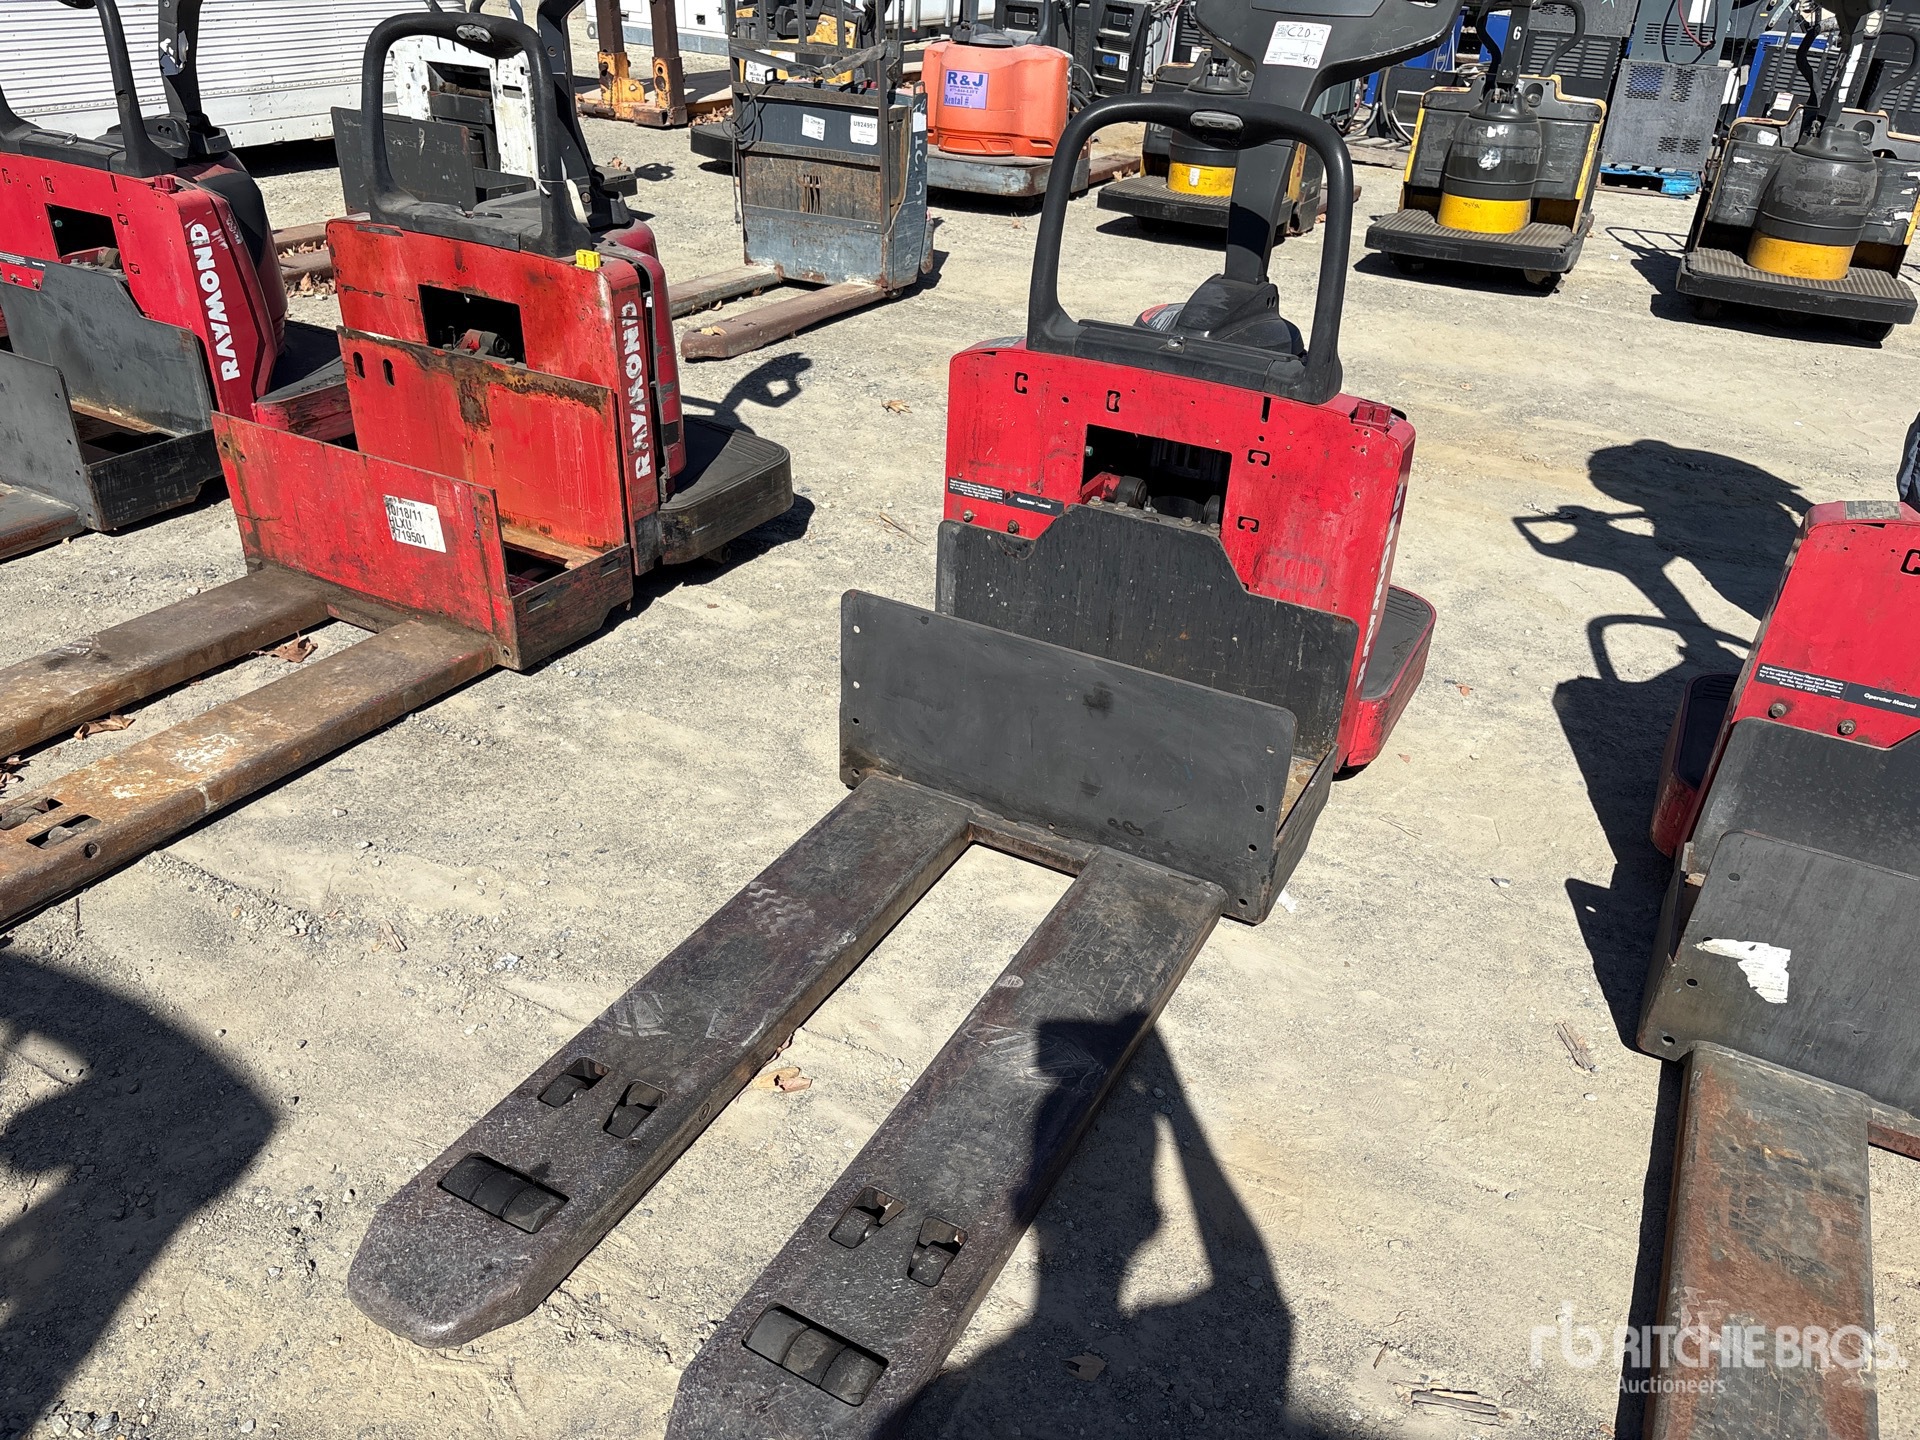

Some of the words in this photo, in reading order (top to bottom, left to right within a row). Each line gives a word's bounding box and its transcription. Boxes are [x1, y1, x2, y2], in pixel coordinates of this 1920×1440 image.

[1513, 26, 1522, 40] 6
[947, 72, 958, 84] R
[960, 75, 970, 85] &
[972, 75, 983, 87] J
[190, 223, 241, 382] RAYMOND
[621, 301, 651, 479] RAYMOND
[386, 504, 423, 522] 10/18/11
[1356, 482, 1404, 690] RAYMOND
[1864, 692, 1893, 704] Operator
[1892, 698, 1917, 710] Manual
